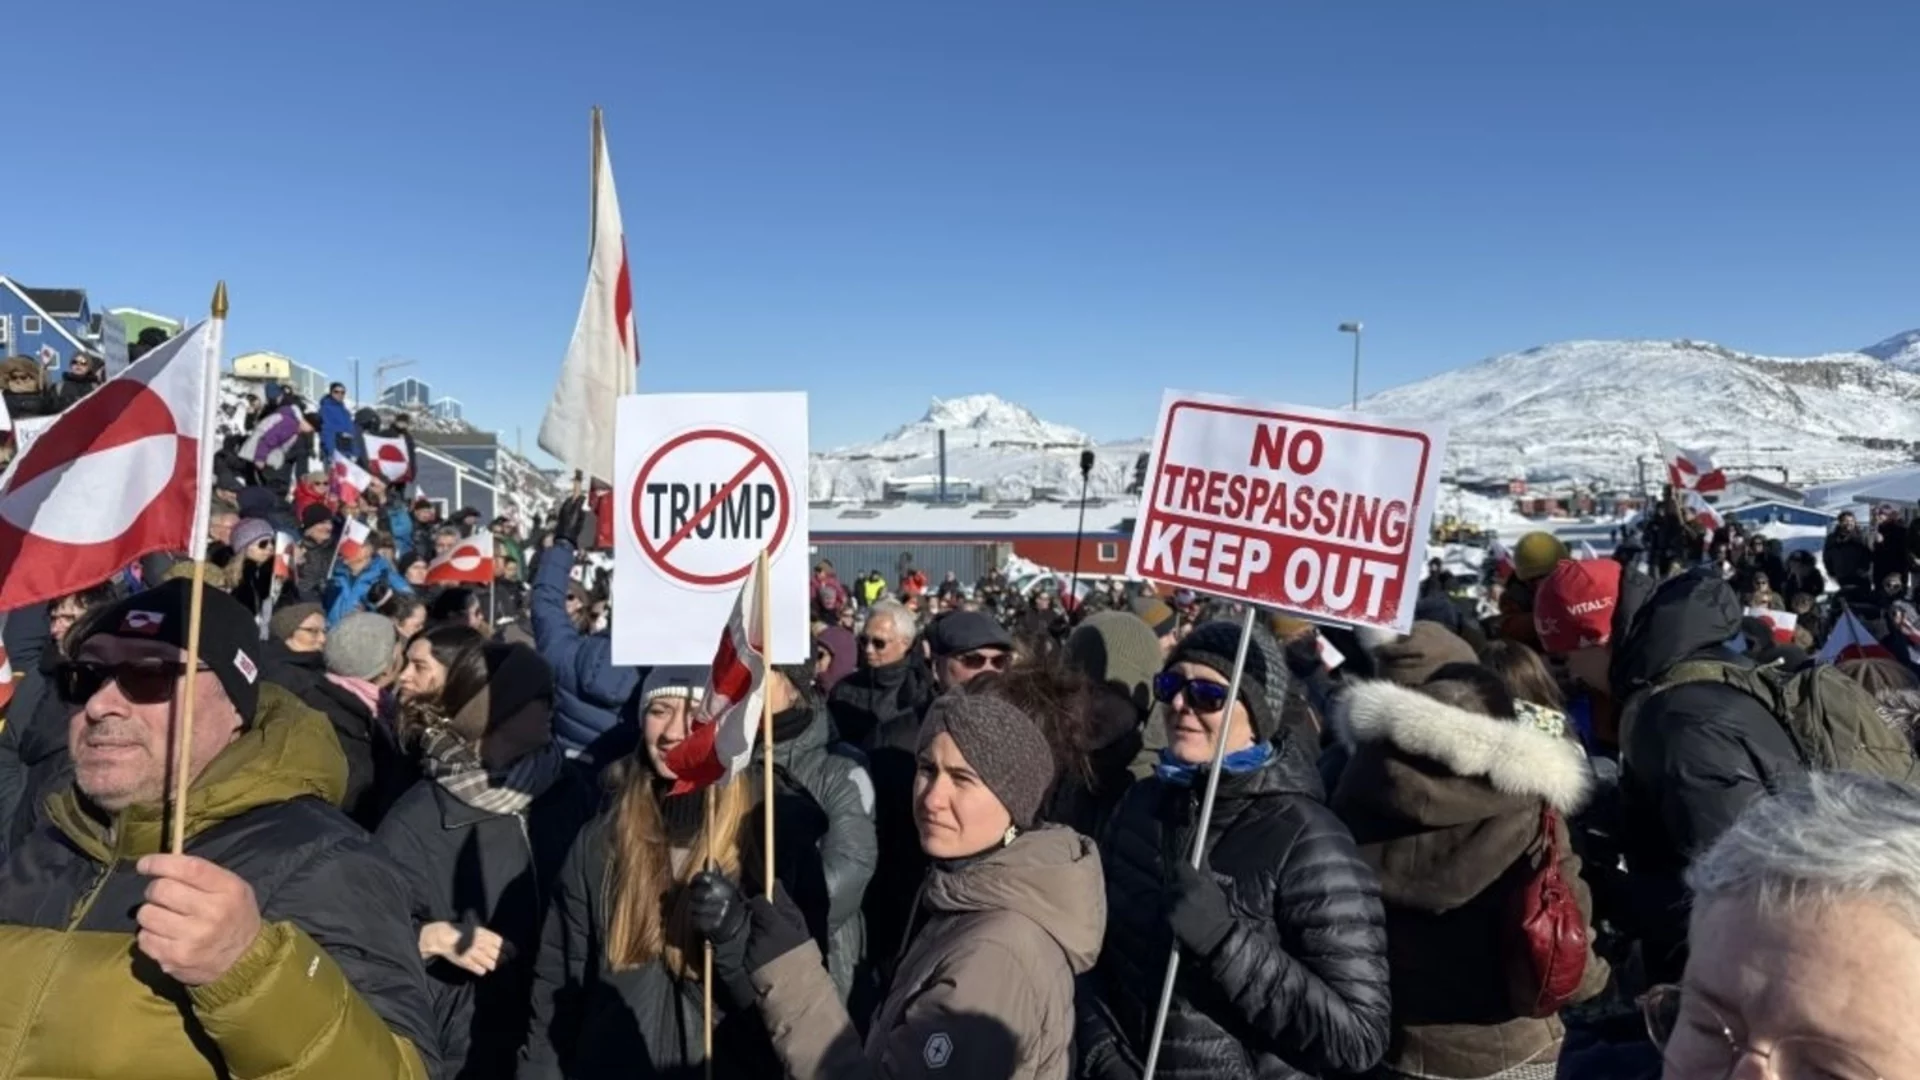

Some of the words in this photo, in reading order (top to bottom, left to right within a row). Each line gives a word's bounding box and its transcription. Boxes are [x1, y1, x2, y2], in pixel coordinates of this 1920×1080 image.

[1250, 423, 1323, 475] NO
[646, 483, 776, 540] TRUMP
[1163, 464, 1407, 547] TRESPASSING
[1144, 520, 1272, 590] KEEP
[1283, 547, 1399, 617] OUT
